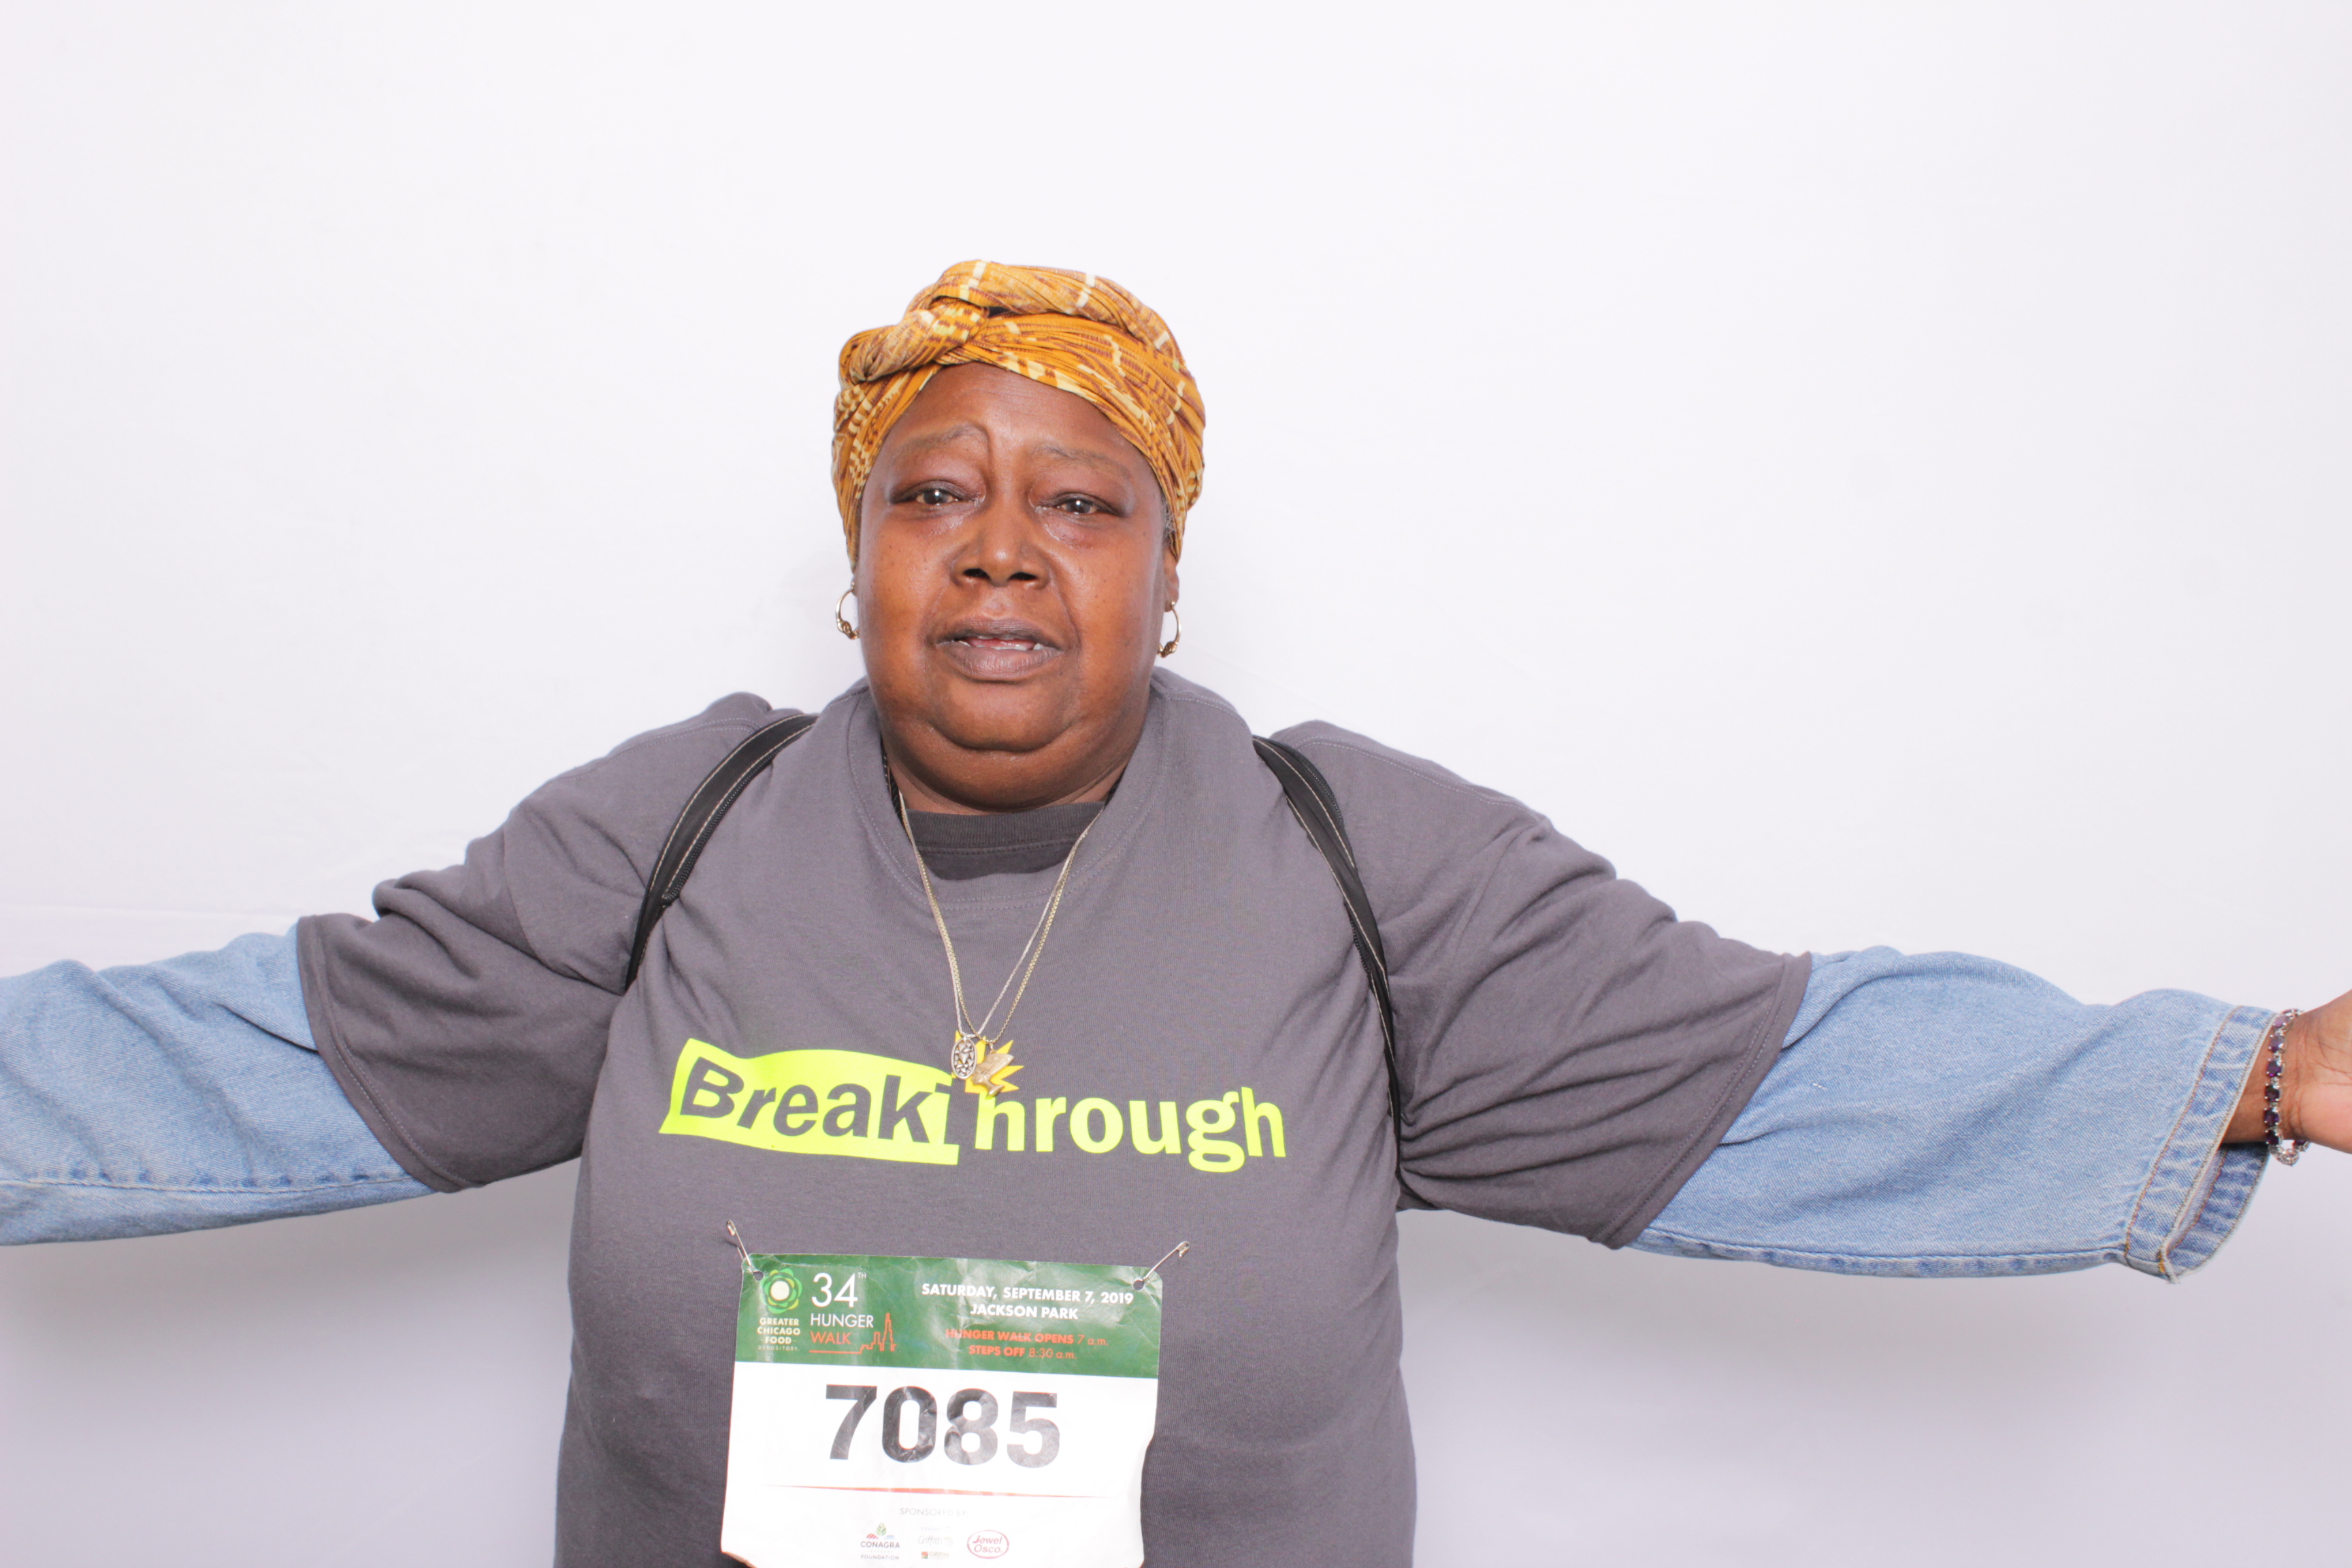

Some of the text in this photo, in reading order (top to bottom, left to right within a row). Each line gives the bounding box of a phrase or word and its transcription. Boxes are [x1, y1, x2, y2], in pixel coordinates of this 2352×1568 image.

[921, 1284, 1134, 1305] SATURDAY, SEPTEMBER 7, 2019
[970, 1303, 1078, 1320] JACKSON PARK
[759, 1317, 800, 1326] GREATER
[811, 1313, 874, 1328] HUNGER
[757, 1326, 801, 1336] CHICAGO
[810, 1331, 851, 1345] WALK
[945, 1328, 1109, 1345] HUNGER WALK OPENS 7 a.m.
[765, 1336, 791, 1345] FOOD
[968, 1345, 1077, 1360] STEPS OFF 8:30 a.m.
[826, 1384, 1060, 1468] 7085
[900, 1507, 953, 1516] SPONSORED
[918, 1535, 943, 1546] Griffith
[973, 1535, 1002, 1545] Jewel
